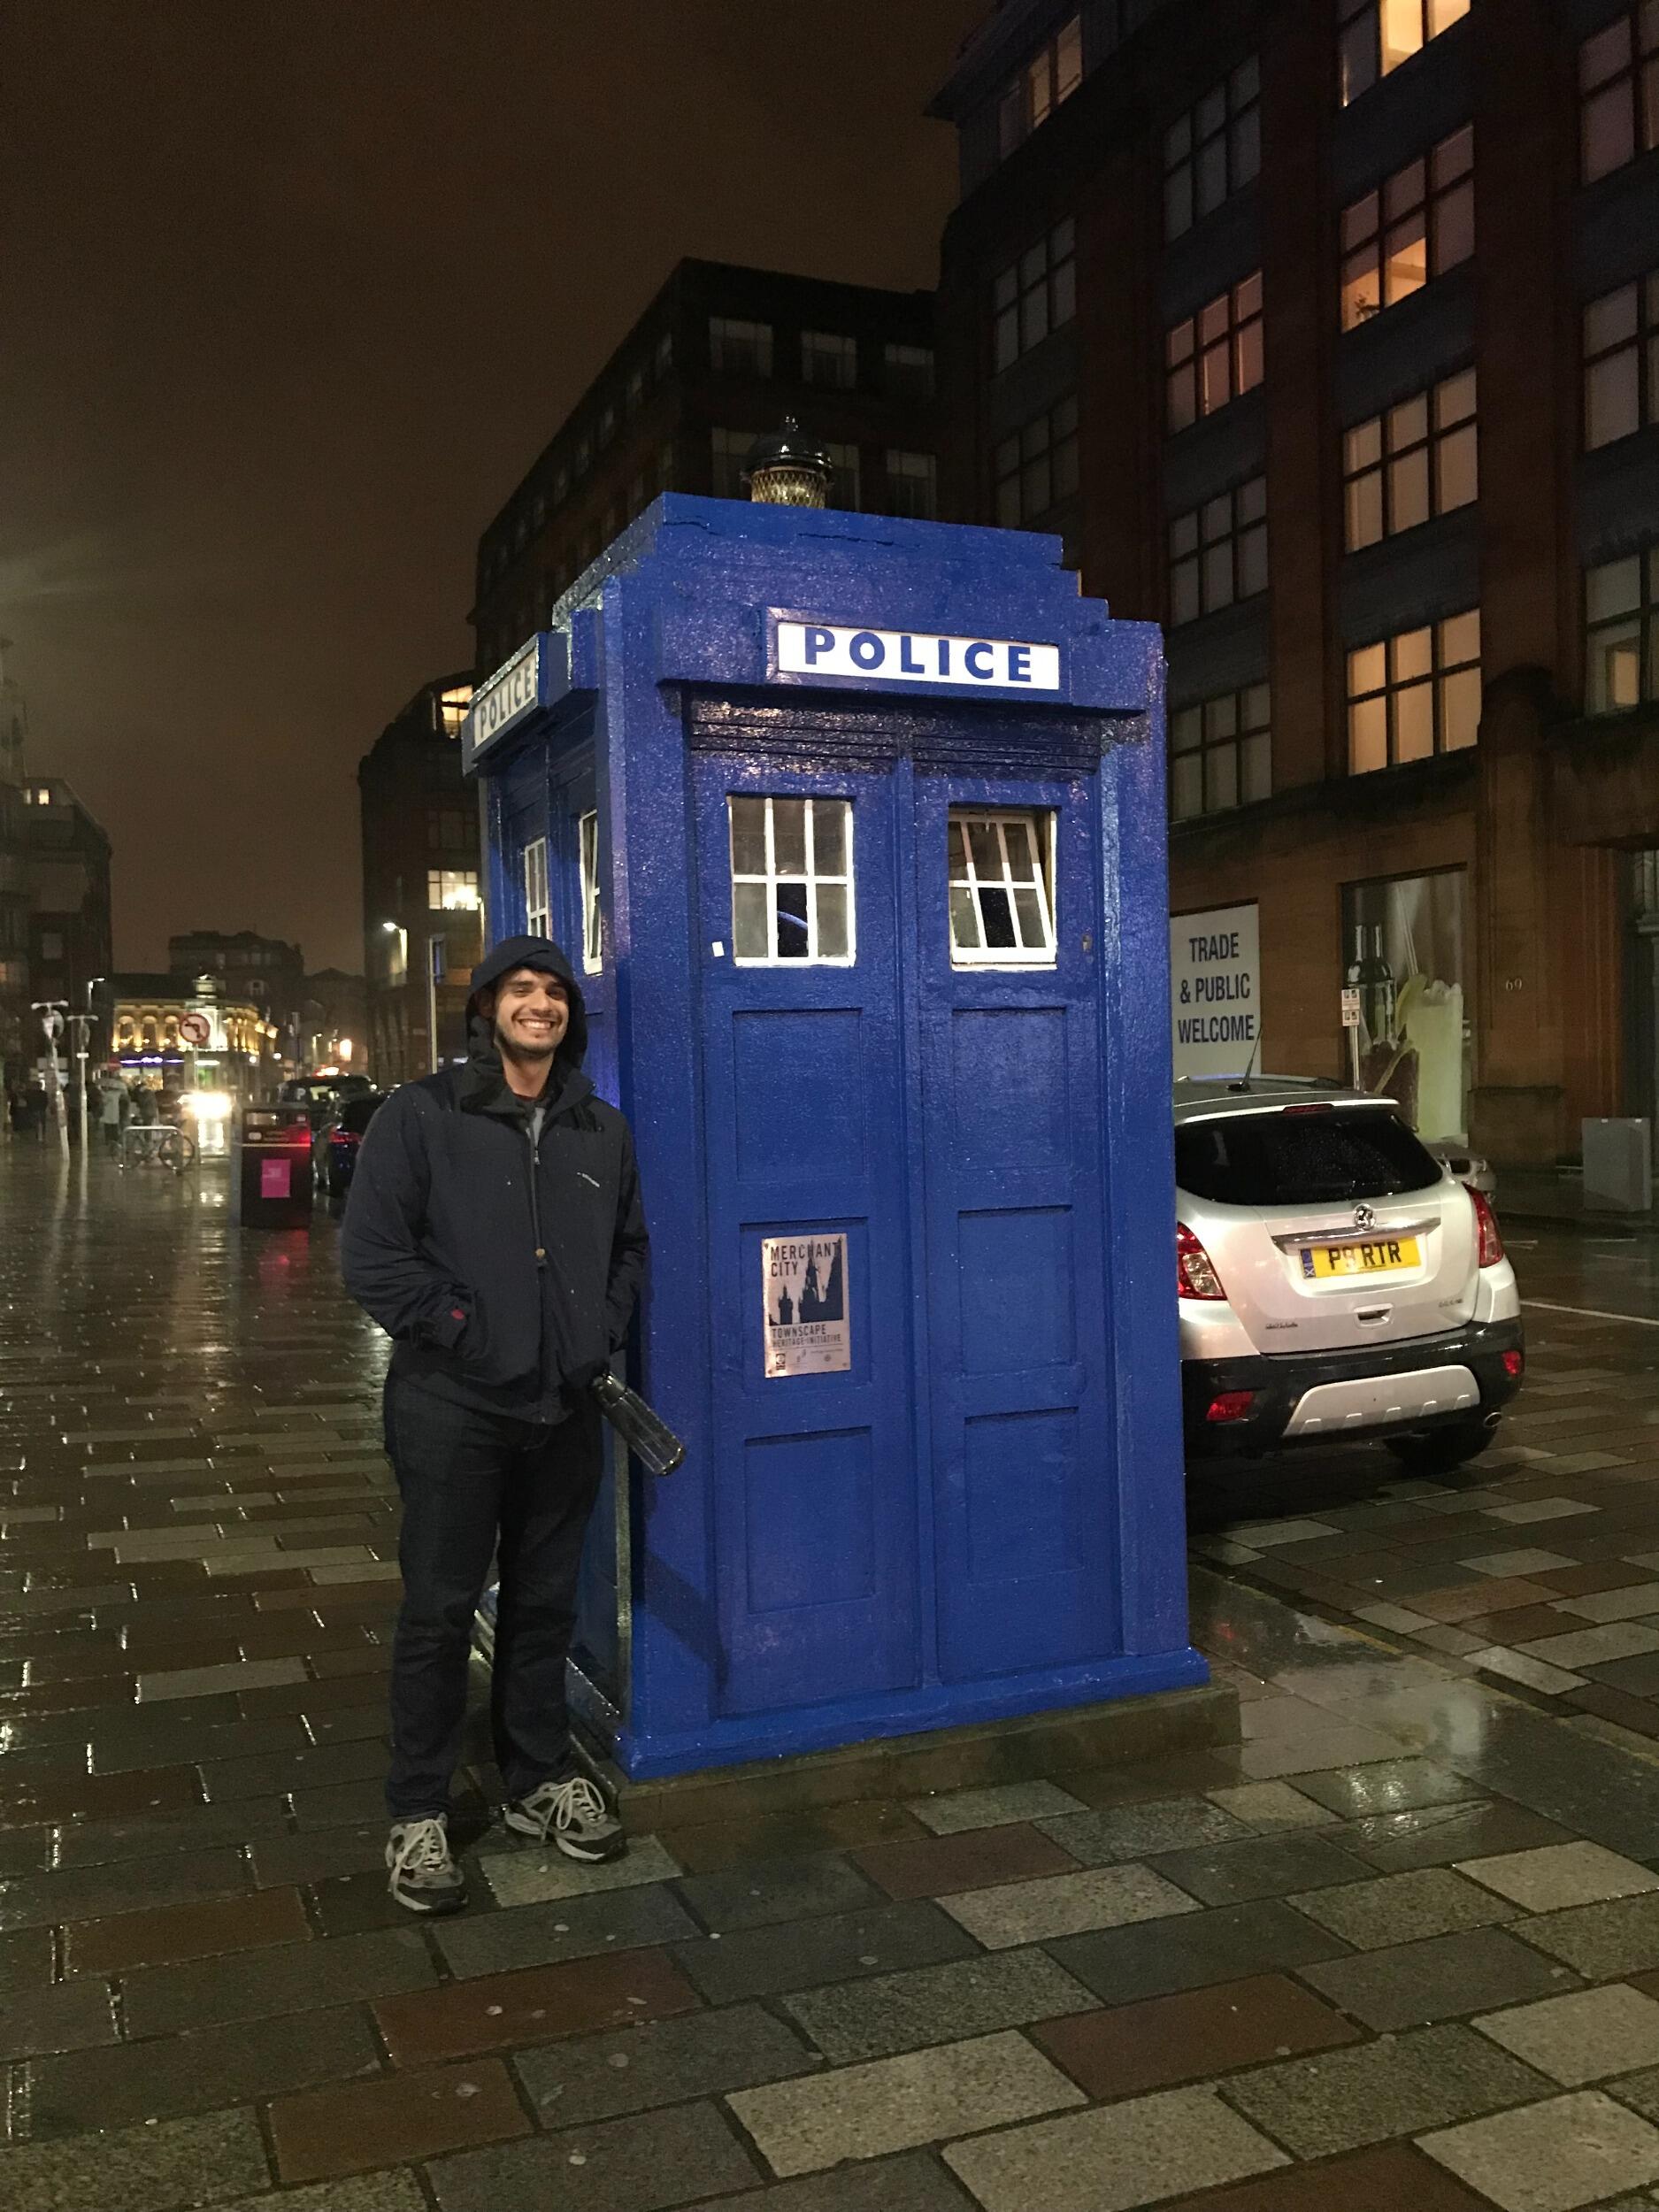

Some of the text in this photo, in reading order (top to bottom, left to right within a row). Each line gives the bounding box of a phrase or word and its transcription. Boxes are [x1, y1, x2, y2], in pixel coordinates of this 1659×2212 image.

[804, 626, 1033, 682] POLICE
[480, 664, 532, 738] POLICE
[1189, 932, 1240, 963] TRADE
[1180, 972, 1250, 1004] & PUBLIC
[1178, 1015, 1255, 1044] WELCOME
[771, 1241, 841, 1261] MERCHANT
[1361, 1240, 1402, 1267] RTR
[771, 1261, 798, 1278] CITY
[772, 1324, 826, 1339] TOWNSCAPE
